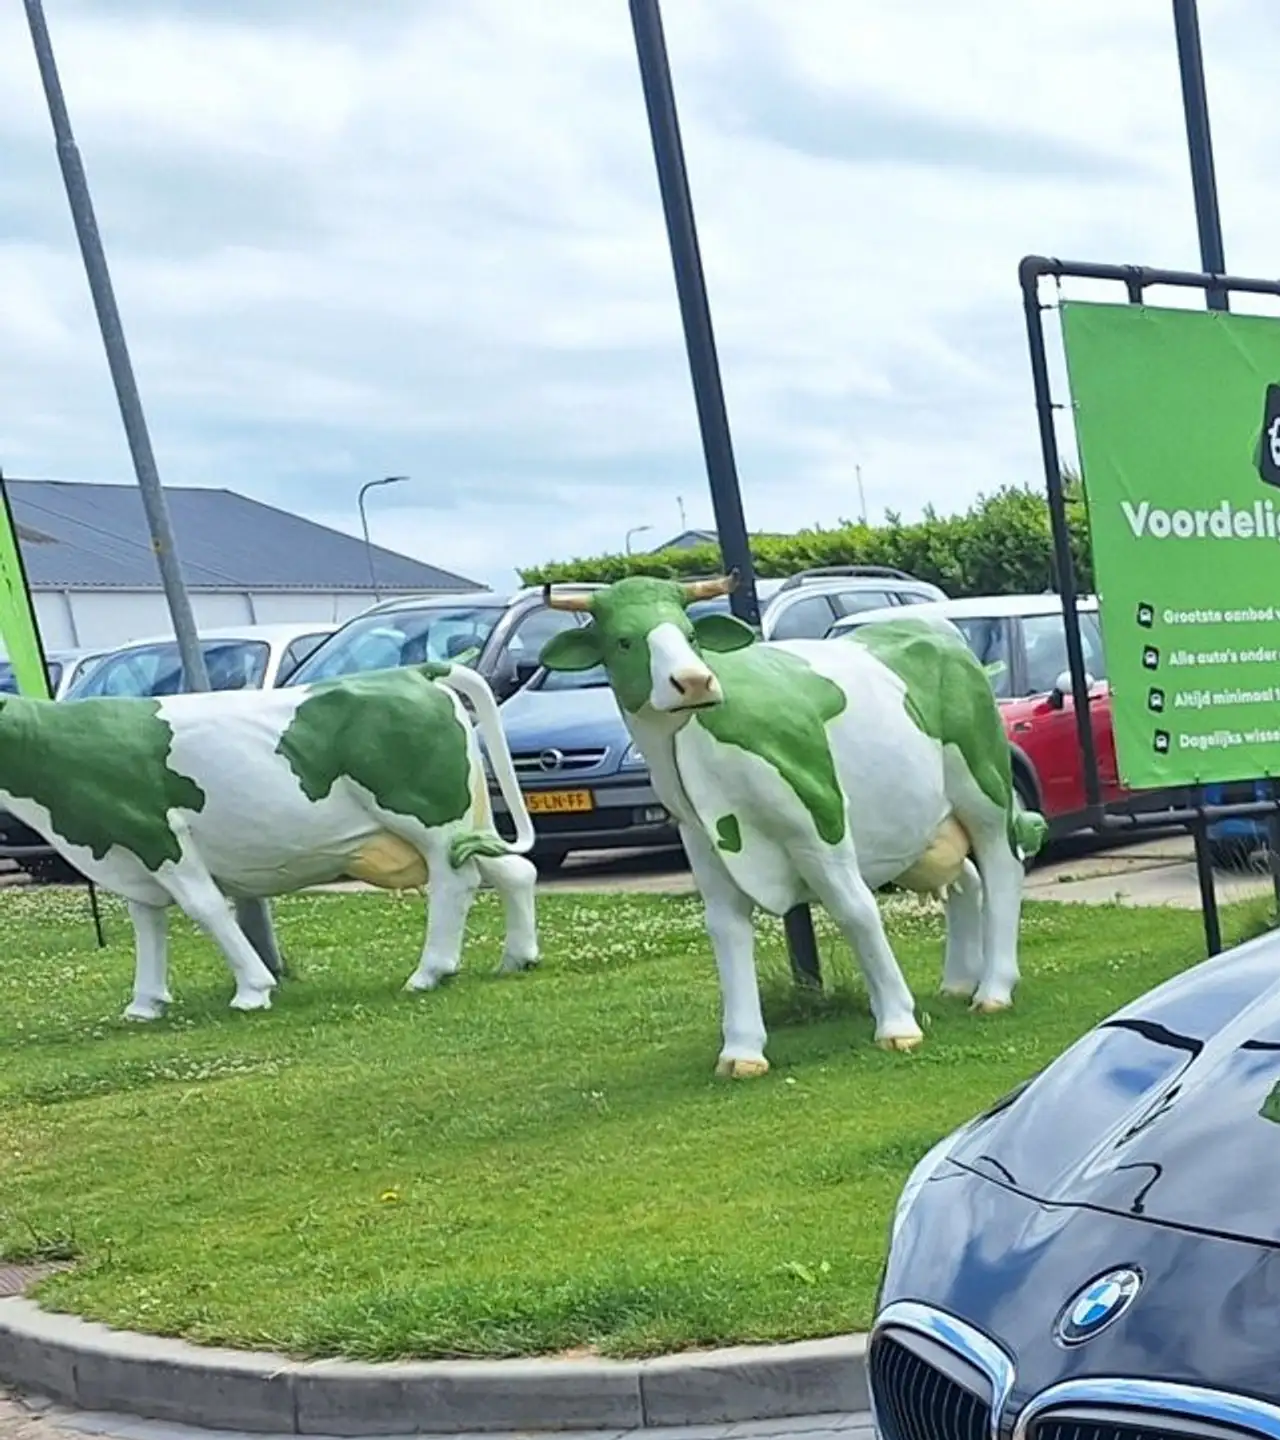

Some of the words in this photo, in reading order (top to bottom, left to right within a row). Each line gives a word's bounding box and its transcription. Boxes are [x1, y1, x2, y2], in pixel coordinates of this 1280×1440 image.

[1163, 607, 1221, 624] Grootste
[1223, 605, 1274, 621] aanbod
[1168, 650, 1195, 666] Alle
[1196, 648, 1238, 664] auto's
[1239, 646, 1277, 662] onder
[1174, 690, 1212, 709] Altijd
[1212, 682, 1273, 705] minimaal
[1179, 729, 1243, 751] Dagelijks
[529, 792, 586, 809] 5-LN-FF
